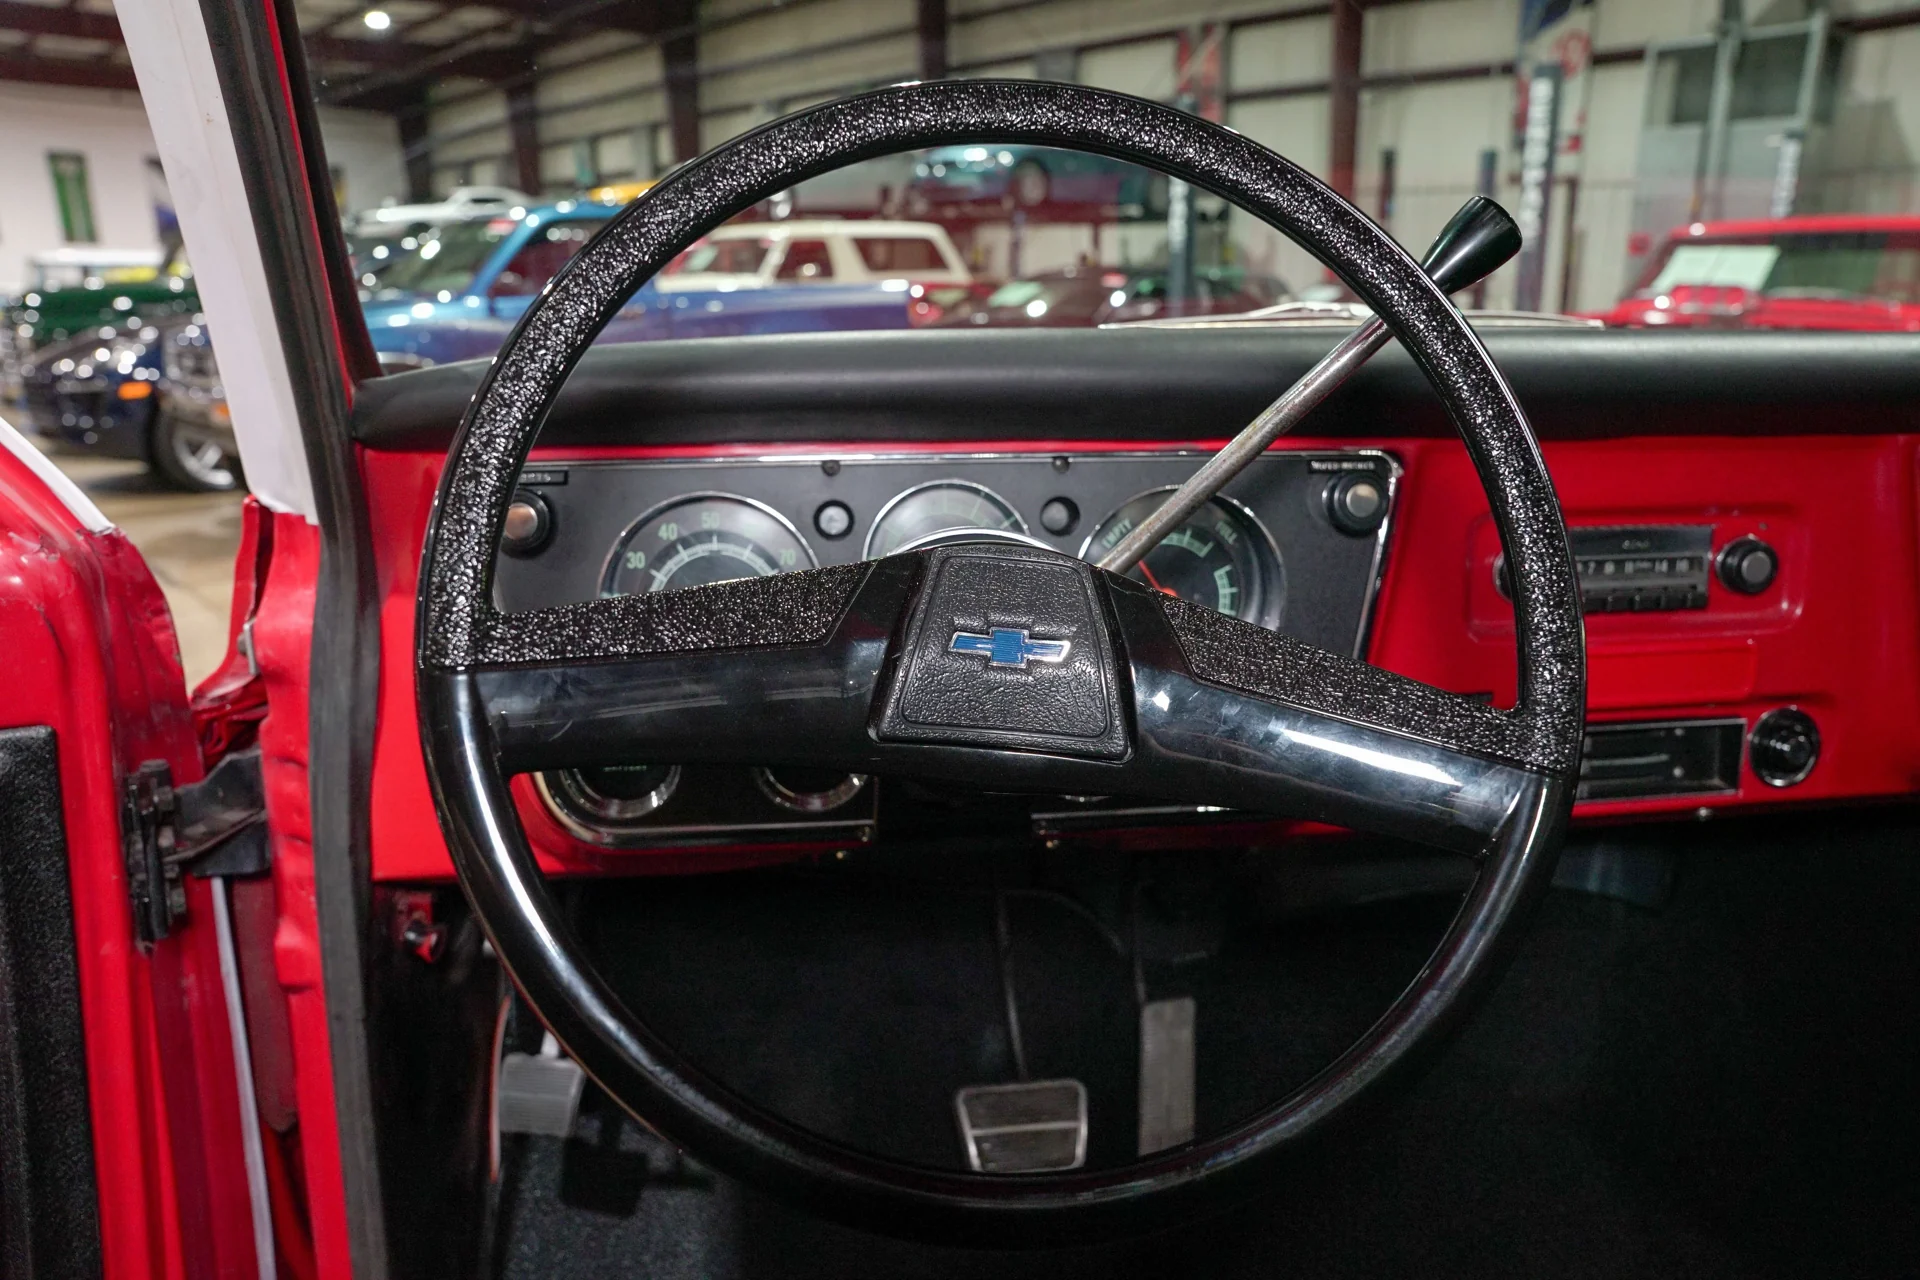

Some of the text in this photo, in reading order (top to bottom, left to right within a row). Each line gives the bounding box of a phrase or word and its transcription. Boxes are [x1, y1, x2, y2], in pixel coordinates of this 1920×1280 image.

[701, 512, 720, 529] 50
[657, 522, 679, 541] 40
[626, 552, 646, 569] 30
[779, 550, 797, 566] 70
